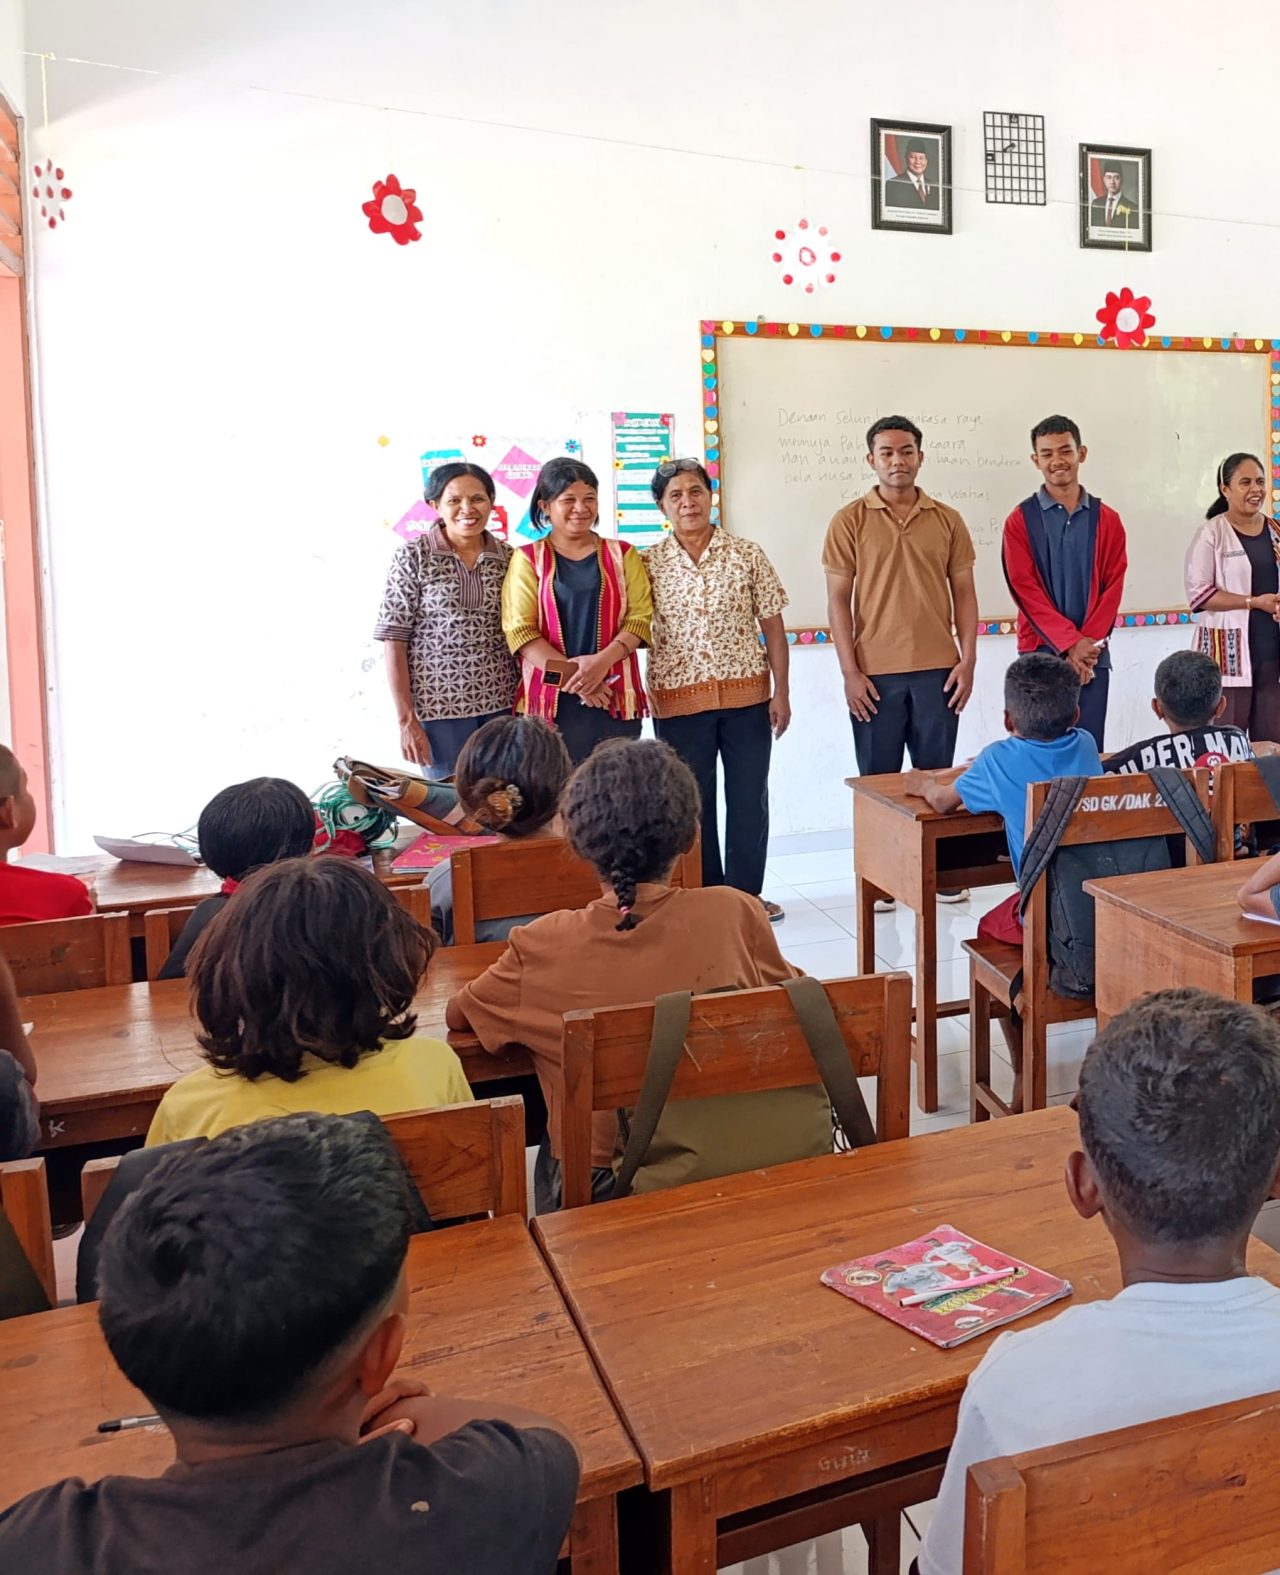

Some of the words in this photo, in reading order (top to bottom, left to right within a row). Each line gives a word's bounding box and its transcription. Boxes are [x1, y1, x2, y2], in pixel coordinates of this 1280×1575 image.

[1104, 734, 1196, 775] UPER
[1101, 792, 1151, 811] GK/DAK
[1155, 793, 1168, 808] 2
